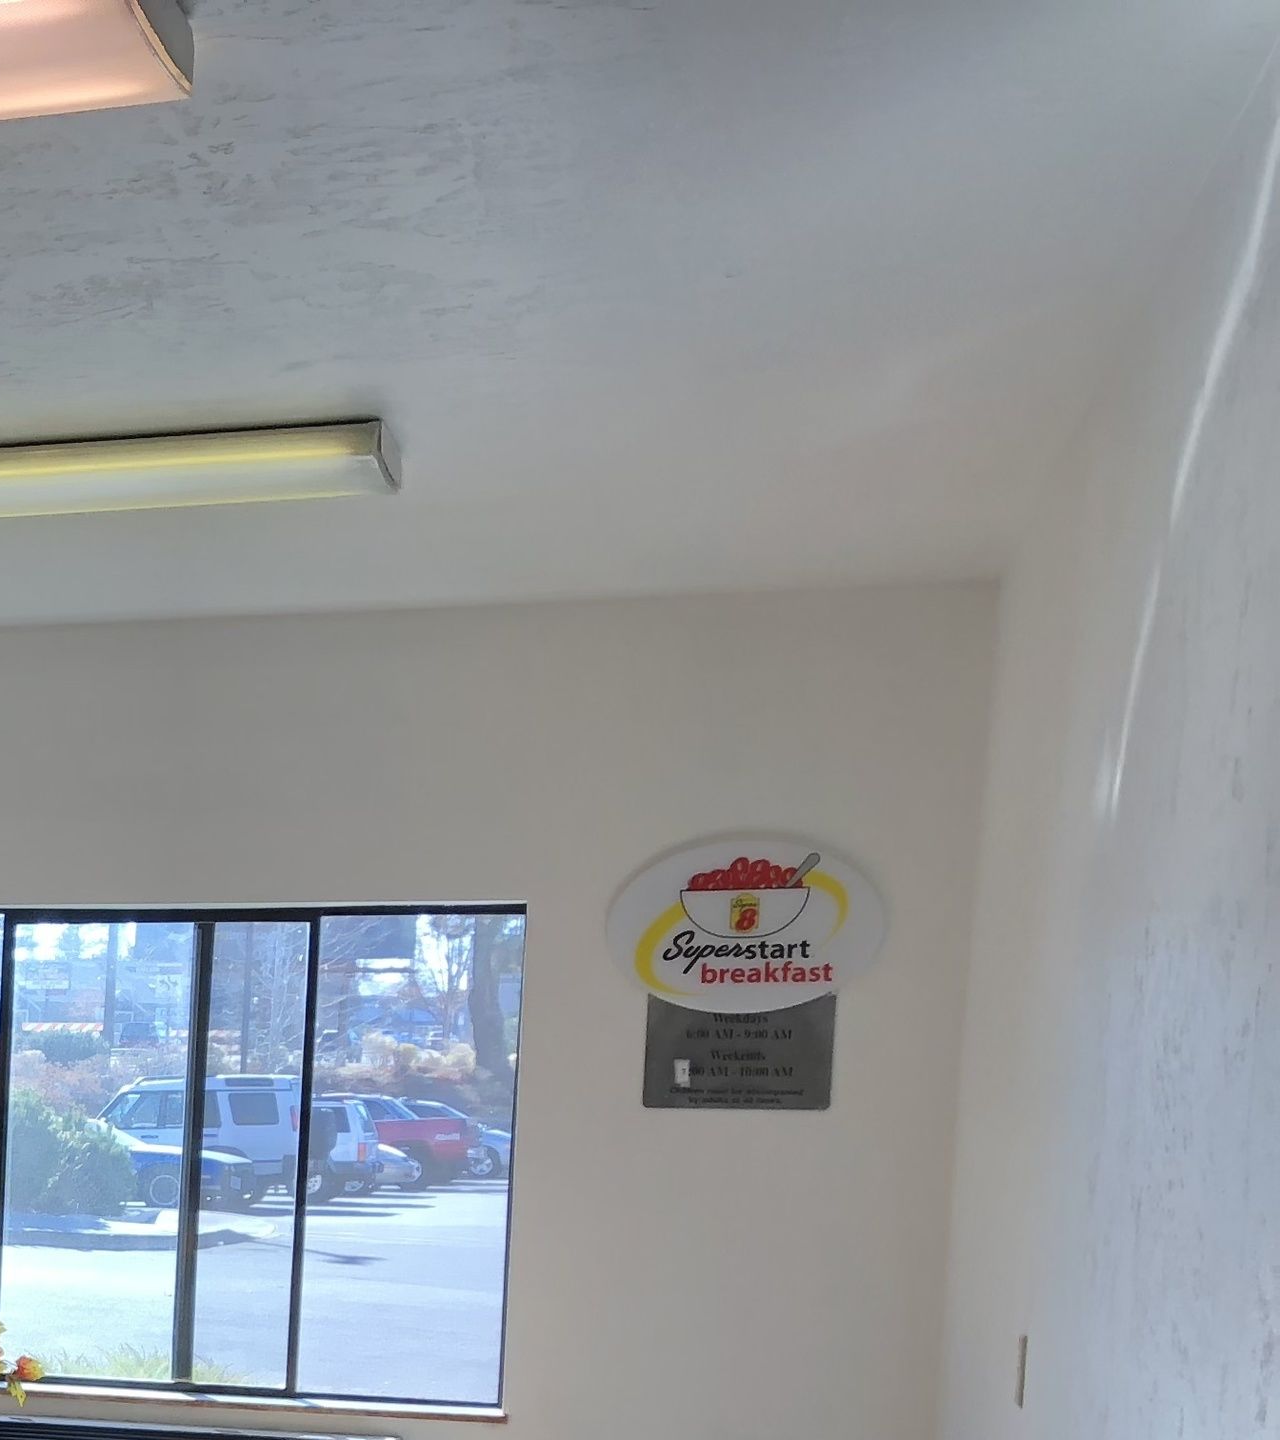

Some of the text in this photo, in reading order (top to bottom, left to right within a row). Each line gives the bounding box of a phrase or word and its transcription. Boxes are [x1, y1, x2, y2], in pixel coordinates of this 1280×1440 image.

[736, 908, 757, 931] 8
[662, 930, 810, 975] Superstart
[701, 961, 833, 984] breakfast
[712, 1013, 769, 1024] Weekdays
[715, 1029, 734, 1040] AM
[744, 1029, 768, 1040] 9:00
[772, 1029, 792, 1040] AM
[709, 1066, 729, 1077] AM
[772, 1066, 793, 1077] AM
